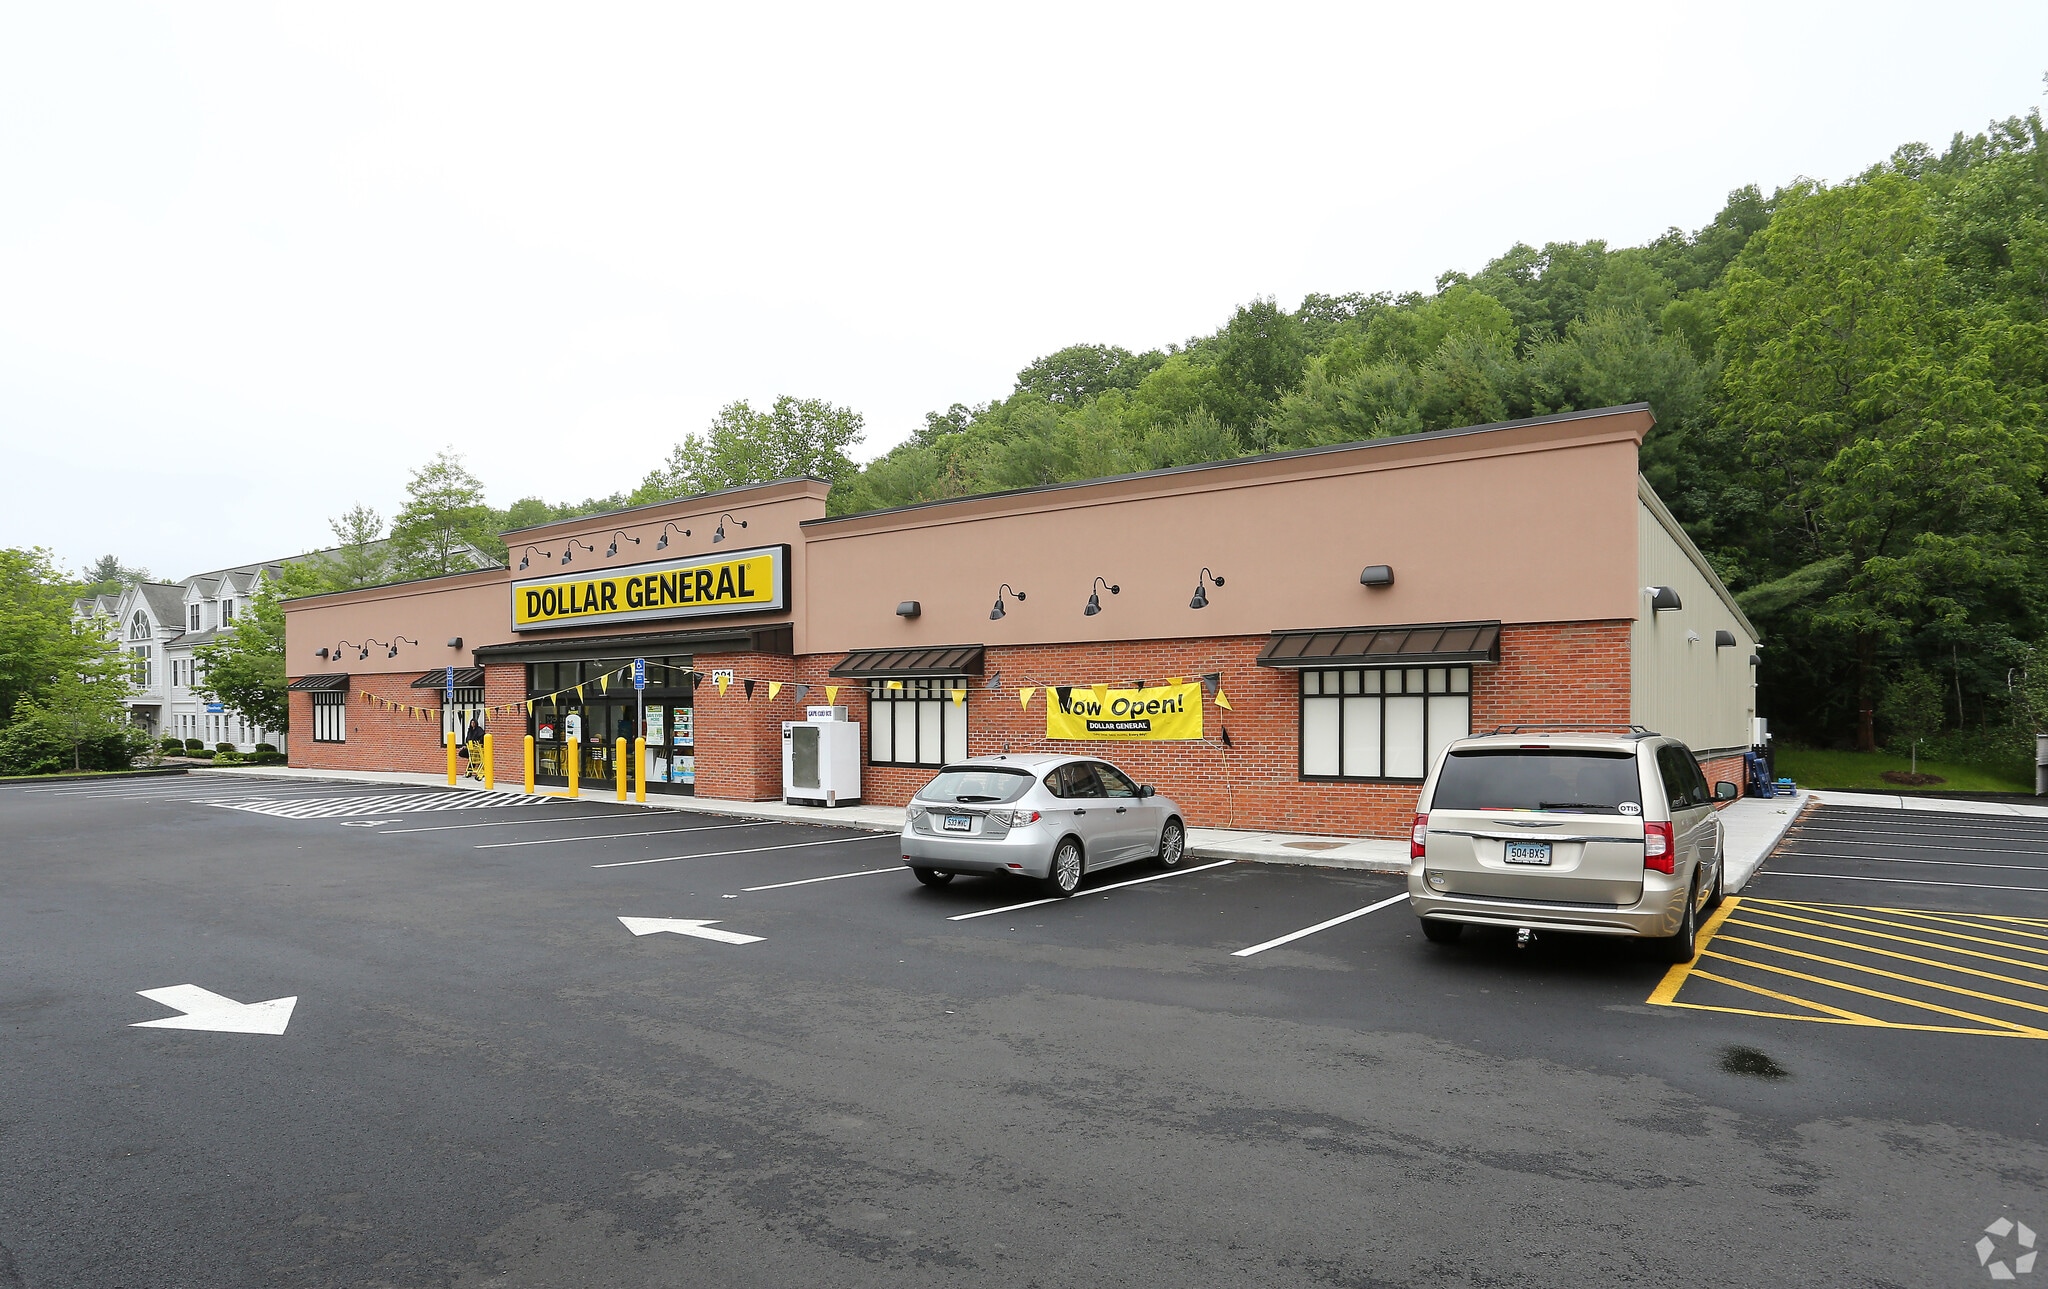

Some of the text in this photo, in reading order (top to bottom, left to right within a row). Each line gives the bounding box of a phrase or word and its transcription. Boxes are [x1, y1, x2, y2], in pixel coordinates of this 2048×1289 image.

[526, 563, 754, 618] DOLLAR GENERAL
[1059, 693, 1183, 719] Now Open!
[1089, 722, 1148, 730] DOLLAR GENERAL
